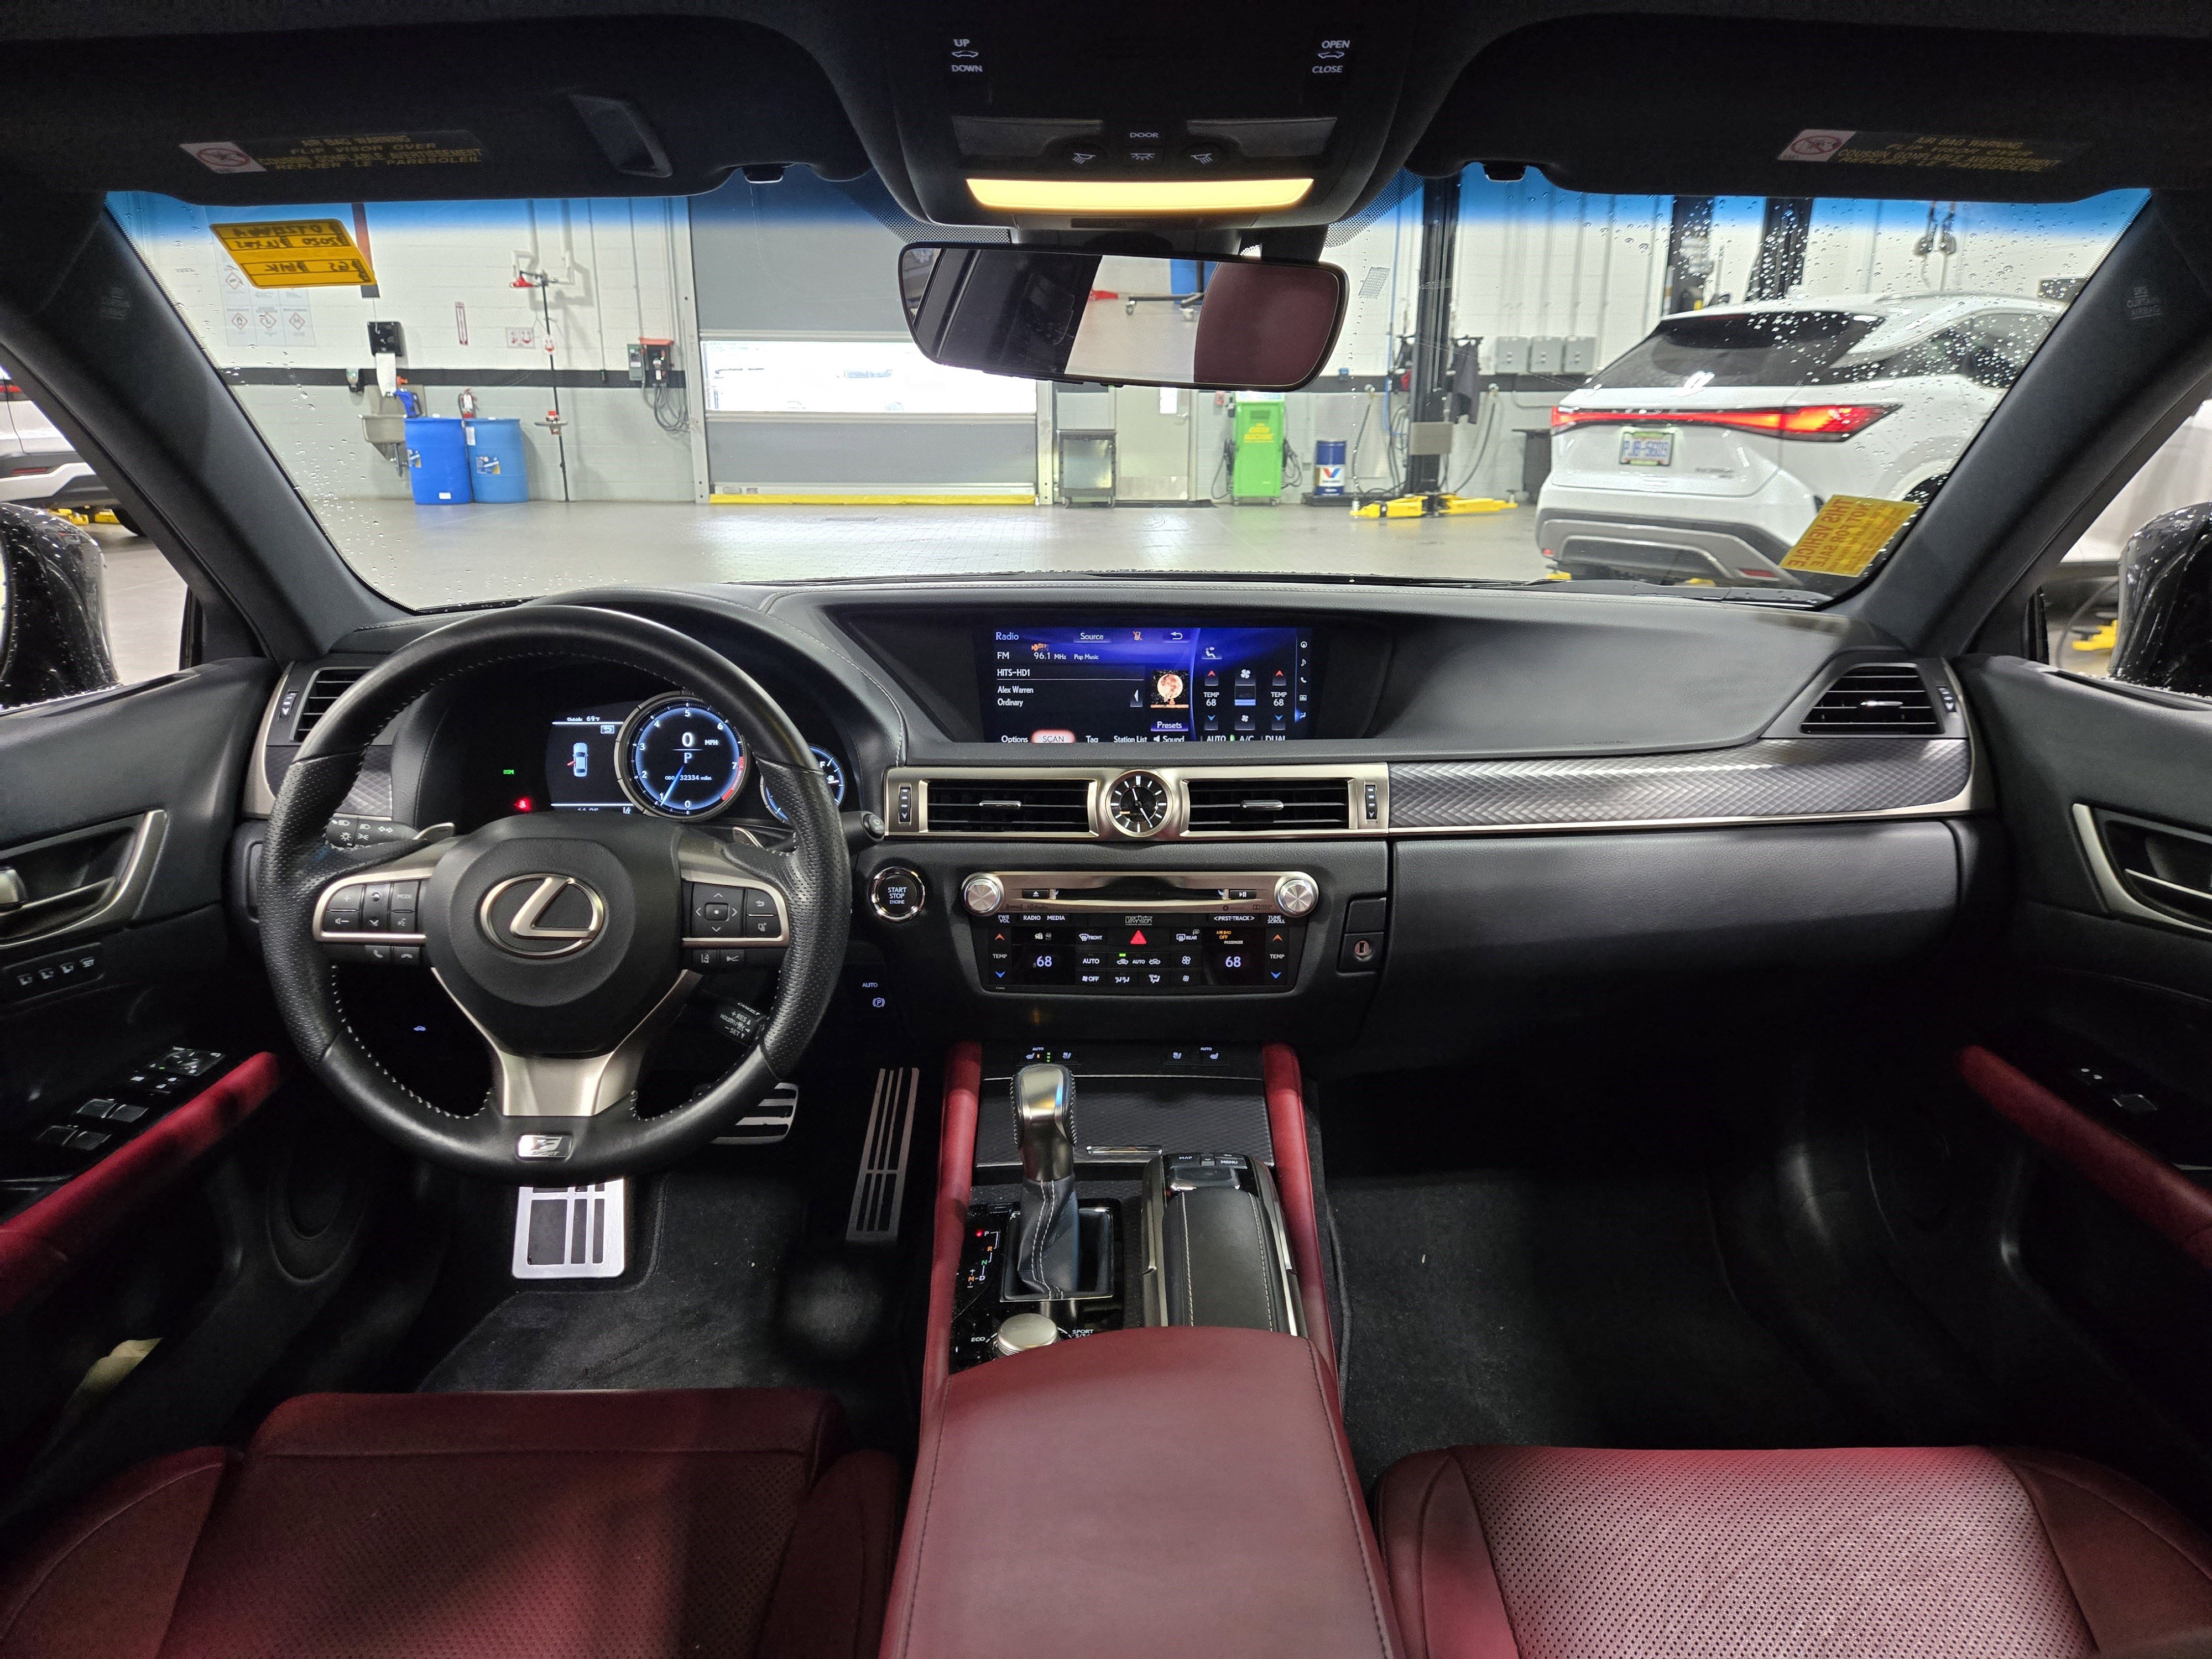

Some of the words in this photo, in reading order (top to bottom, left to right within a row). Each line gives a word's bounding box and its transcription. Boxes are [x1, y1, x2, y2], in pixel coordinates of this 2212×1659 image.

[954, 39, 969, 47] UP
[1322, 40, 1350, 49] OPEN
[951, 65, 983, 73] DOWN
[1312, 65, 1343, 74] CLOSE
[389, 148, 482, 160] AVERTISSEMENT
[1838, 149, 1890, 159] COUSSIN
[388, 156, 482, 166] PARESOLEIL
[996, 632, 1019, 640] Radio
[997, 698, 1023, 707] Ordinary
[682, 732, 693, 747] 0
[684, 753, 692, 764] P
[1036, 956, 1052, 967] 68
[1225, 956, 1241, 968] 68
